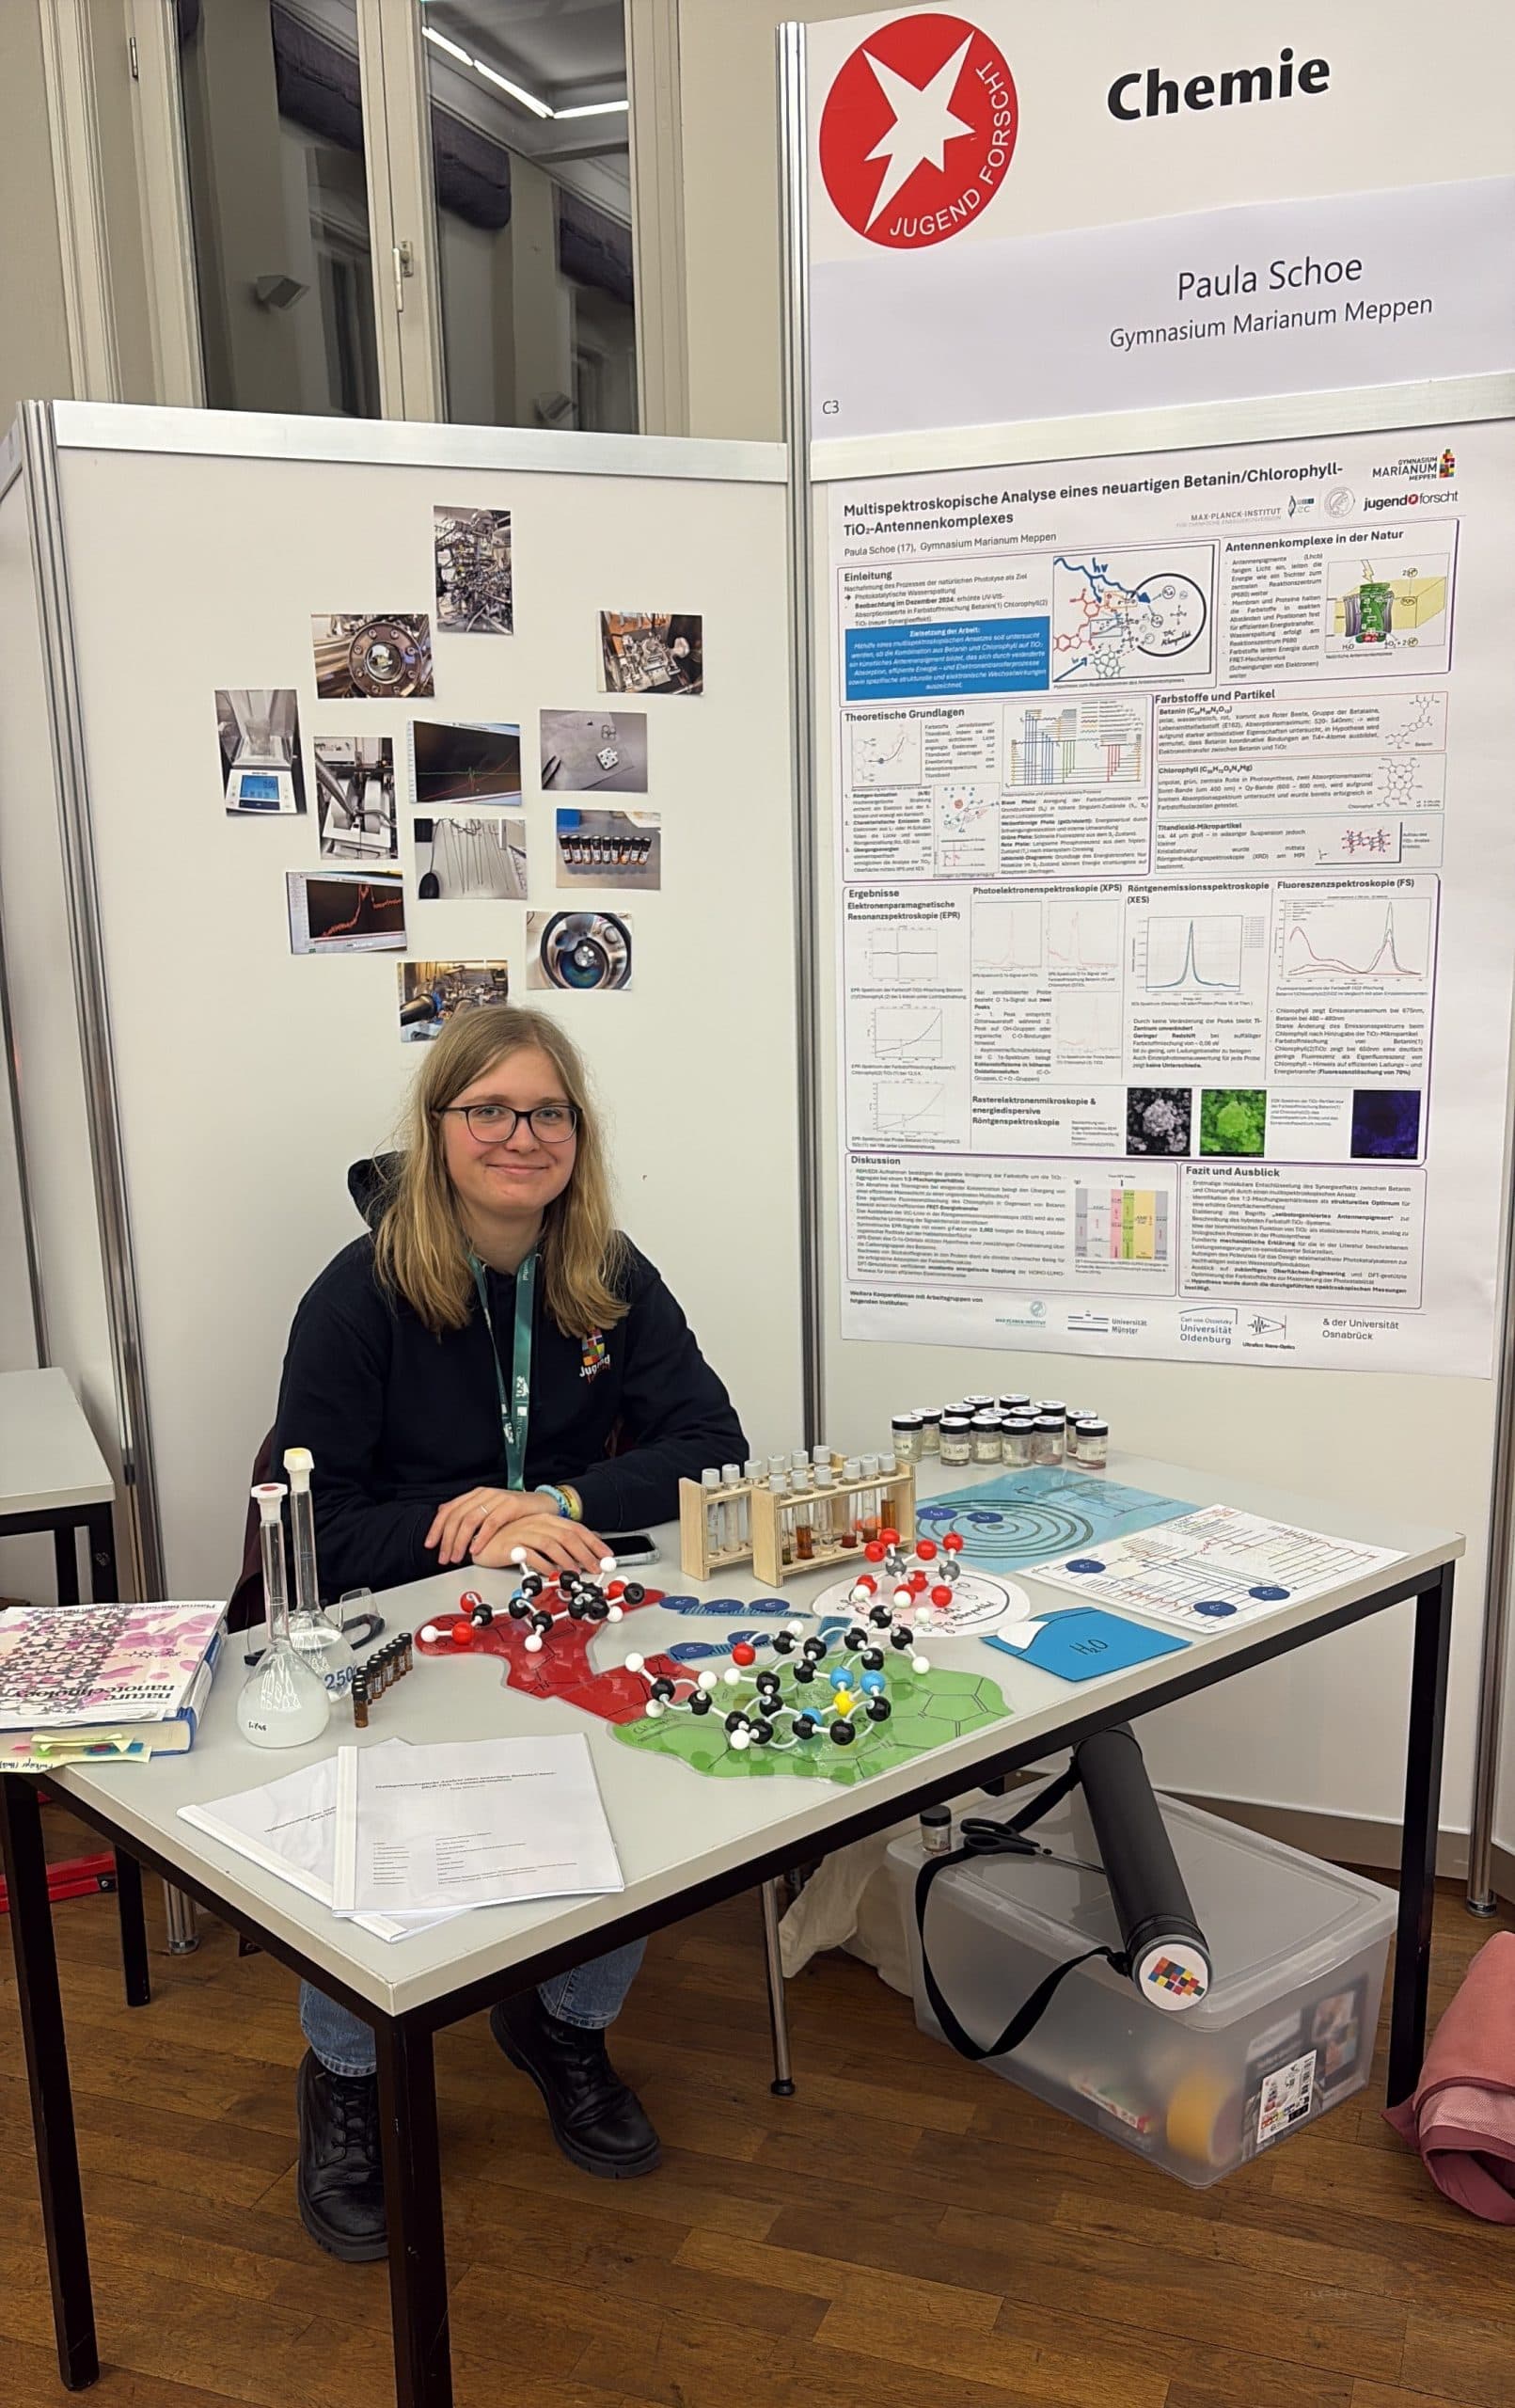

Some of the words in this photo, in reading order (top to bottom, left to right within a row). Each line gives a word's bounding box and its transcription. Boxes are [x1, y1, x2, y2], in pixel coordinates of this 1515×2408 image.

[1107, 48, 1331, 122] Chemie
[889, 186, 982, 240] JUGEND
[978, 59, 1013, 186] FORSCHT
[1177, 265, 1257, 301] Paula
[1269, 257, 1363, 291] Schoe
[1110, 317, 1224, 351] Gymnasium
[1233, 306, 1336, 335] Marianum
[1346, 295, 1433, 326] Meppen
[822, 400, 840, 415] C3
[1397, 456, 1438, 466] GYMNASIUM
[1372, 463, 1438, 478] MARIANUM
[1409, 473, 1437, 482] MEPPEN
[844, 493, 998, 517] Multispektroskopische
[1002, 484, 1056, 504] Analyse
[1060, 485, 1098, 499] eines
[1102, 474, 1180, 496] neuartigen
[1183, 462, 1343, 490] Betanin/Chlorophyll-
[1364, 496, 1408, 512] jugend
[1419, 490, 1459, 505] forscht
[844, 546, 867, 557] Paula
[869, 544, 895, 555] Schoe
[897, 542, 917, 555] (17),
[920, 538, 972, 552] Gymnasium
[974, 535, 1018, 547] Marianum
[1020, 531, 1056, 545] Meppen
[1225, 534, 1334, 553] Antennenkomplexe
[1336, 533, 1347, 545] in
[1349, 531, 1368, 543] der
[1371, 529, 1404, 542] Natur
[844, 571, 892, 583] Einleitung
[1155, 691, 1209, 705] Farbstoffe
[1211, 691, 1231, 703] und
[1234, 689, 1275, 702] Partikel
[845, 709, 907, 722] Theoretische
[908, 707, 965, 722] Grundlagen
[1159, 766, 1198, 774] Chlorophyll
[972, 885, 1098, 895] Photoelektronenspektroskopie
[1099, 883, 1122, 895] (XPS)
[1128, 881, 1270, 893] Röntgenemissionsspektroskopie
[1277, 879, 1396, 891] Fluoreszenzspektroskopie
[1397, 879, 1414, 890] (FS)
[848, 888, 900, 900] Ergebnisse
[1127, 895, 1150, 905] (XES)
[847, 900, 955, 911] Elektronenparamagnetische
[847, 911, 939, 922] Resonanzspektroskopie
[939, 911, 961, 922] (EPR)
[972, 1096, 1089, 1106] Rasterelektronenmikroskopie
[1090, 1097, 1097, 1105] &
[972, 1106, 1041, 1117] energiedispersive
[972, 1117, 1061, 1128] Röntgenspektroskopie
[851, 1156, 901, 1166] Diskussion
[1186, 1165, 1211, 1176] Fazit
[1213, 1167, 1232, 1176] und
[1234, 1166, 1280, 1178] Ausblick
[1112, 1317, 1147, 1327] Universität
[1349, 1320, 1399, 1329] Universität
[1112, 1325, 1139, 1335] Münster
[1180, 1323, 1232, 1334] Universität
[1180, 1333, 1232, 1345] Oldenburg
[1322, 1331, 1373, 1339] Osnabrück
[103, 1692, 171, 1701] nature
